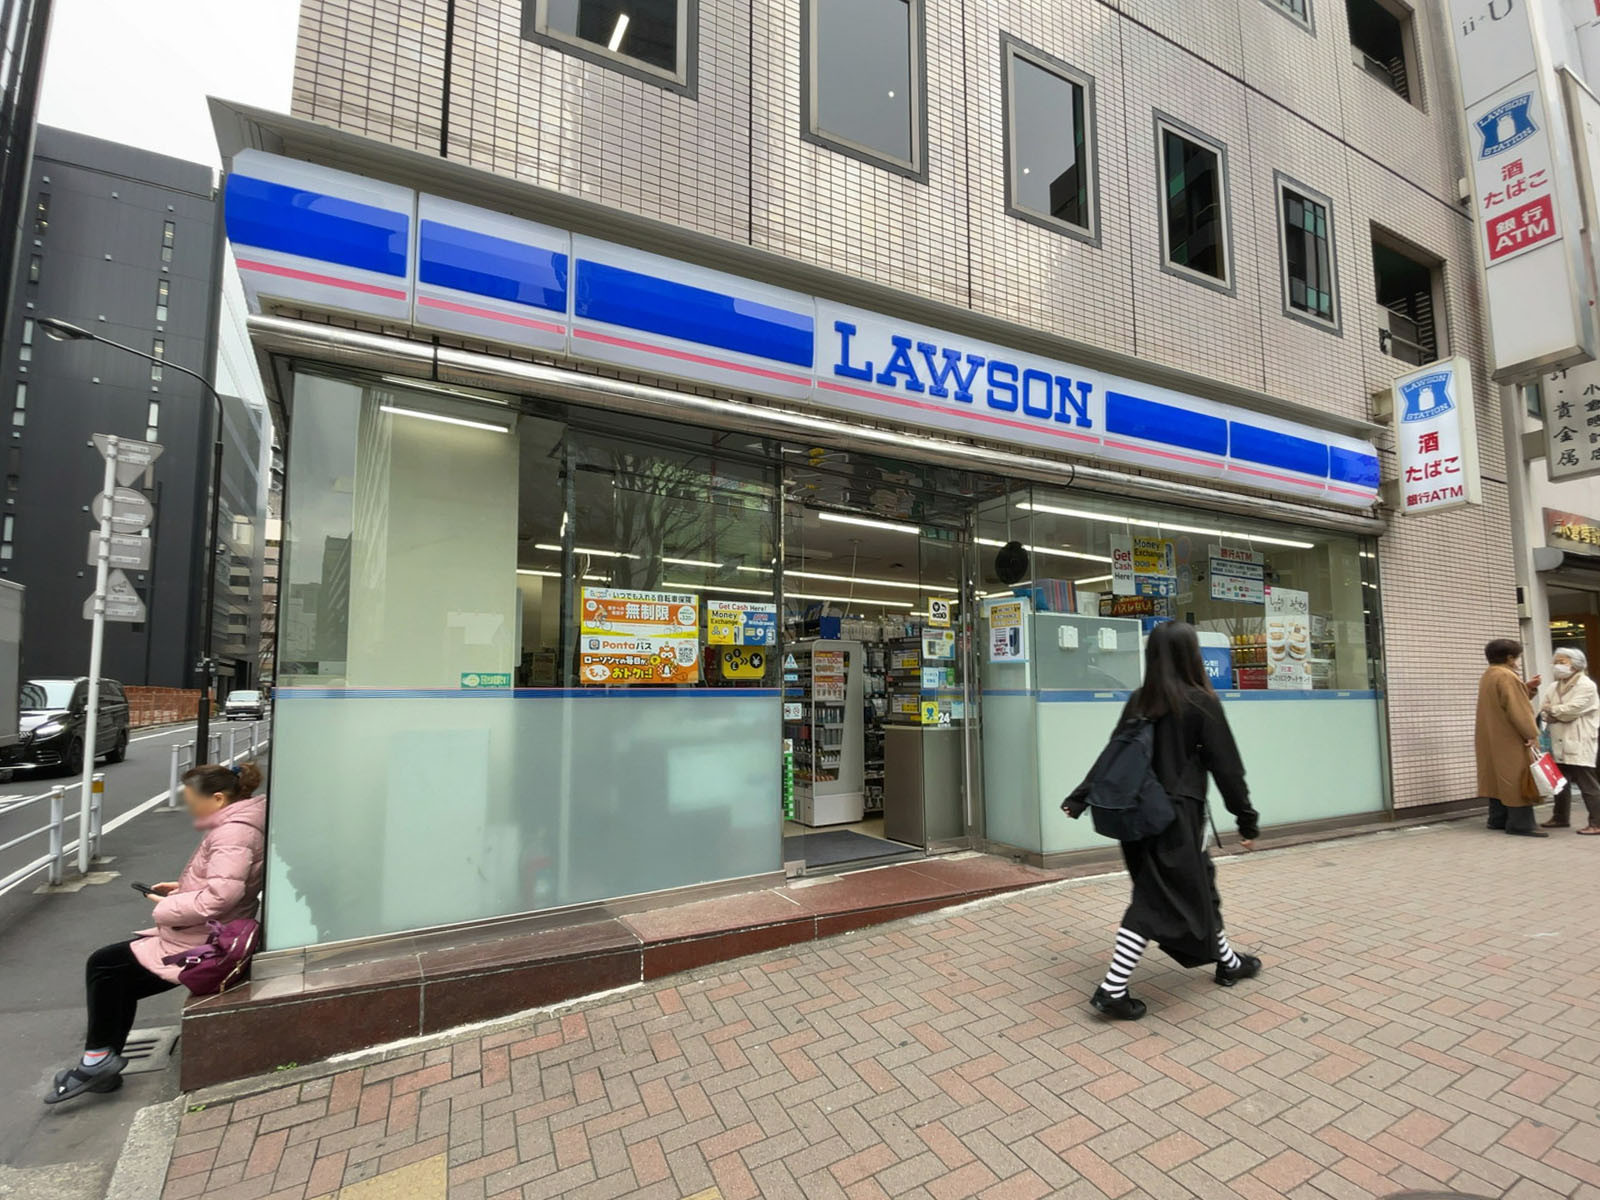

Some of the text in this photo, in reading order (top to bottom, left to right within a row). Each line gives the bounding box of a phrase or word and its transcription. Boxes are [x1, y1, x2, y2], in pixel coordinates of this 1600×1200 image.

[1479, 96, 1528, 127] LAWSON
[1483, 127, 1533, 157] STATION
[1501, 158, 1524, 182] 酒
[1483, 169, 1548, 209] たばこ
[1496, 205, 1543, 236] 銀行
[1495, 218, 1550, 252] ATM
[834, 320, 1093, 429] LAWSON
[1404, 373, 1447, 393] LAWSON
[1406, 403, 1449, 421] STATION
[1418, 431, 1440, 455] 酒
[1405, 456, 1461, 484] たばこ
[1406, 485, 1464, 507] 銀行ATM
[1134, 539, 1160, 550] Money
[1134, 548, 1164, 558] Exchange
[1113, 549, 1131, 562] Get
[1220, 548, 1252, 561] 銀行ATM
[1114, 561, 1132, 570] Cash
[1114, 572, 1133, 581] Here!
[625, 603, 669, 620] 無制限
[712, 611, 737, 620] Money
[711, 618, 738, 626] Exchange
[602, 641, 652, 650] Pontaパス
[938, 712, 950, 723] 24
